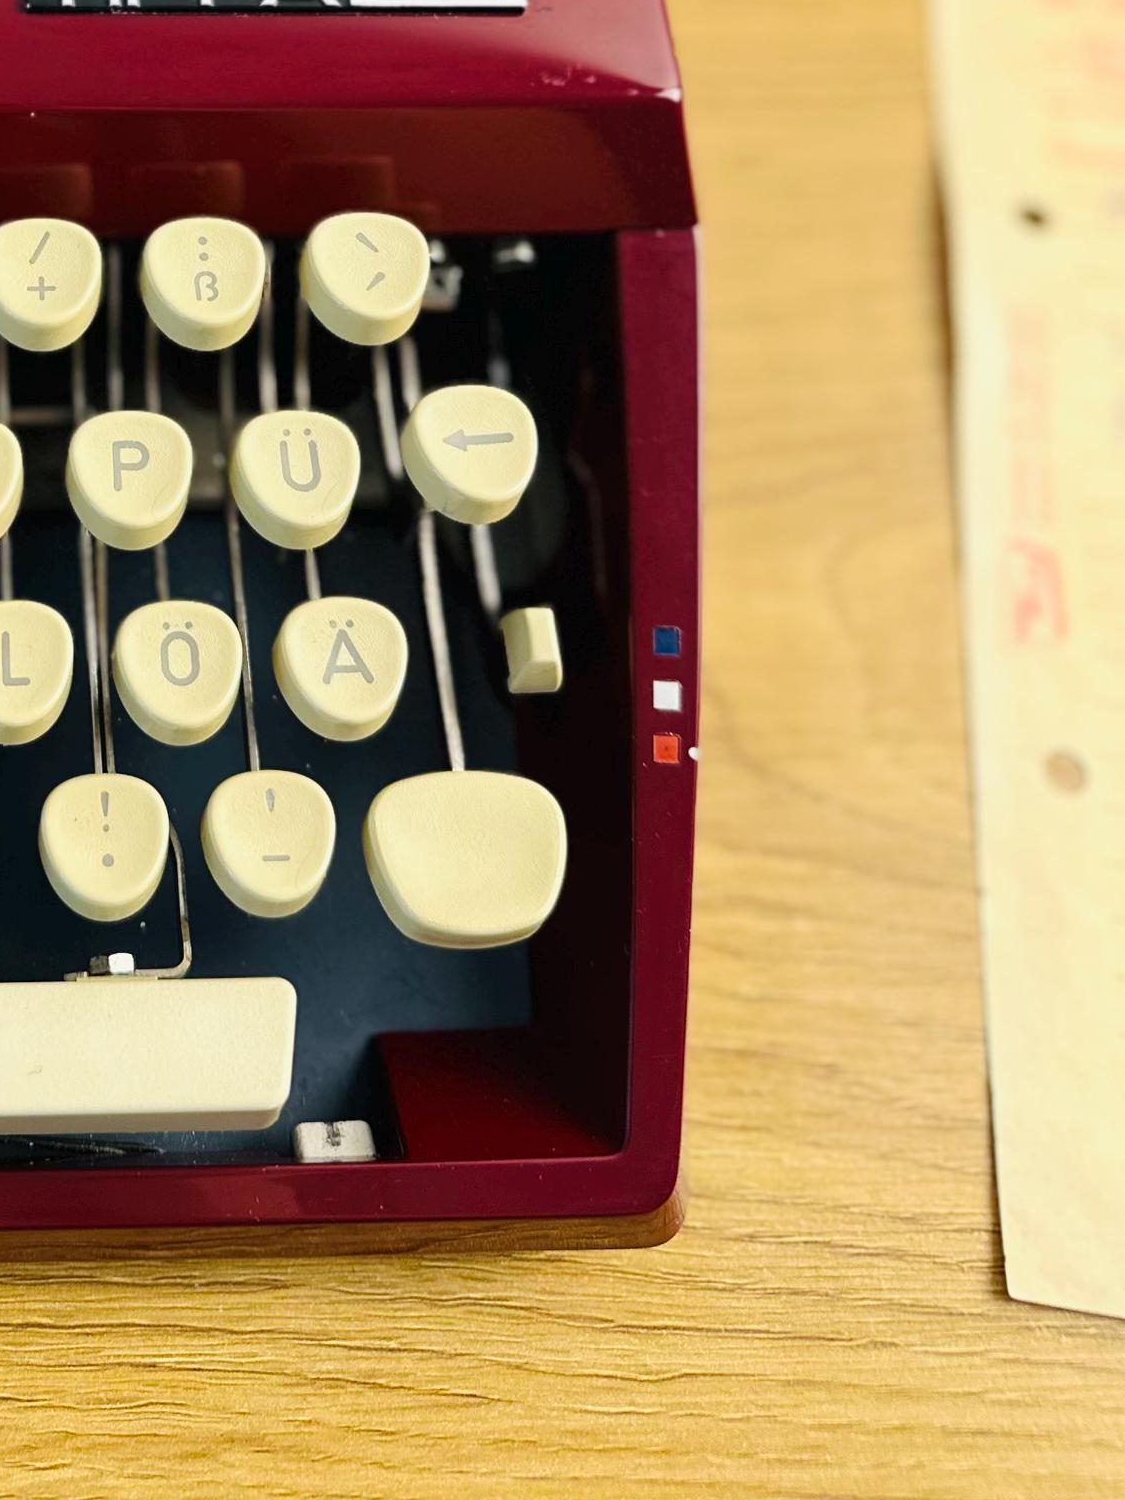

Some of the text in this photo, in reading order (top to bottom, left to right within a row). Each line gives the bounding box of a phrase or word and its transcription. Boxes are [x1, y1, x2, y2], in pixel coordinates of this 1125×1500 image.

[112, 440, 150, 492] P
[279, 428, 322, 493] Ü
[1, 630, 31, 687] L
[160, 621, 201, 687] Ö
[322, 619, 375, 685] Ä
